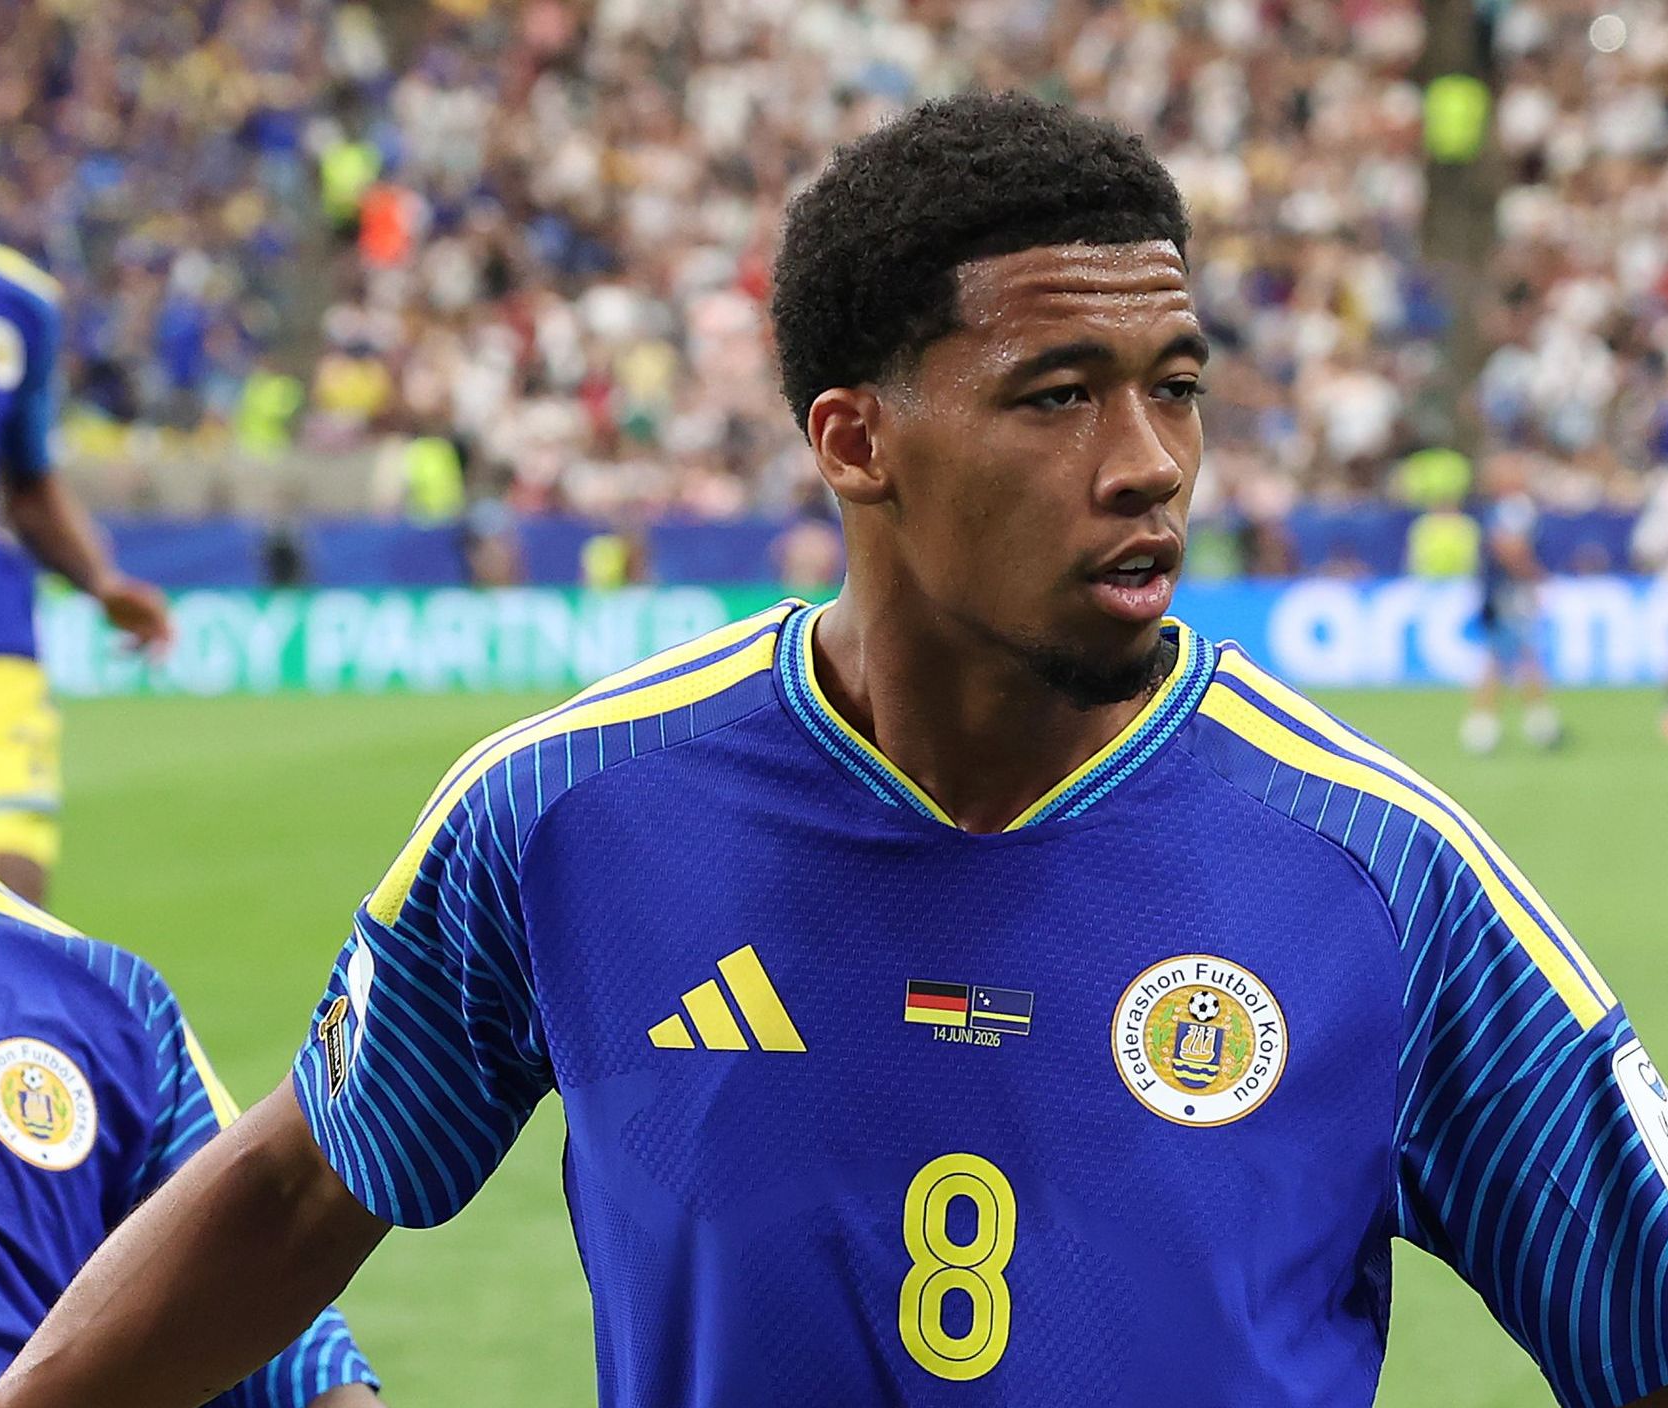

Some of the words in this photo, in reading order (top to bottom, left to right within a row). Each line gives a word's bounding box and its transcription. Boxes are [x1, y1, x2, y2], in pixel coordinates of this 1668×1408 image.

[933, 1026, 947, 1041] 14
[947, 1028, 973, 1044] JUNI
[974, 1031, 1001, 1047] 2026
[1123, 969, 1185, 1092] Federashon
[1195, 963, 1268, 1014] Futbòl
[1233, 1022, 1278, 1102] Kòrsou
[899, 1152, 1018, 1382] 8
